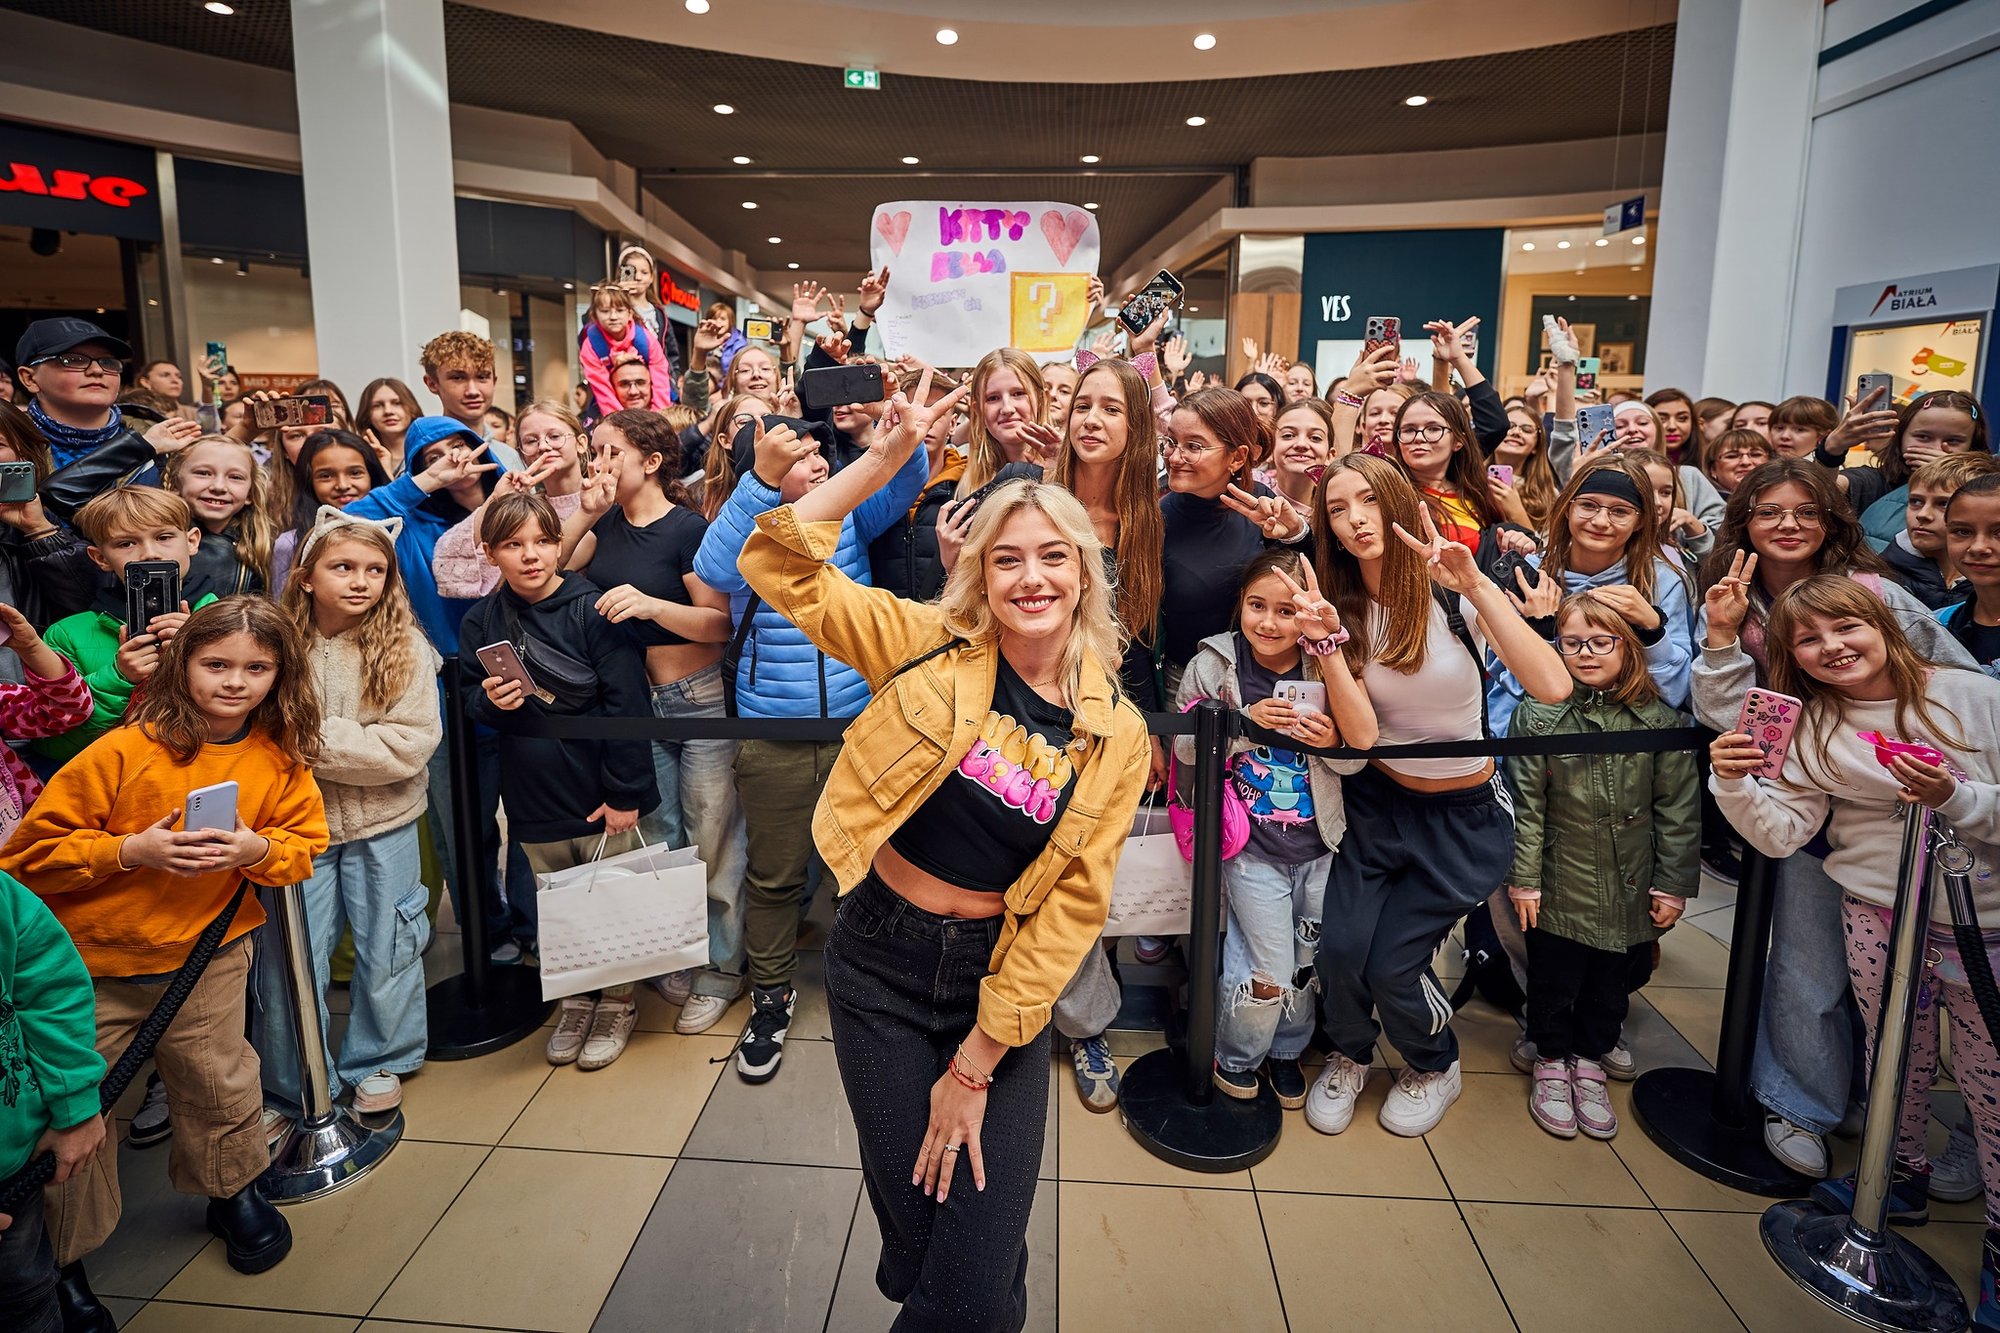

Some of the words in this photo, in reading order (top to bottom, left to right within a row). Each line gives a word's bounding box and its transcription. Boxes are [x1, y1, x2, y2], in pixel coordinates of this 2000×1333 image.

[939, 206, 1032, 247] KITTY
[1897, 287, 1933, 298] ATRIUM
[1321, 295, 1352, 322] YES
[1891, 294, 1937, 311] BIAŁA
[243, 376, 269, 388] MID
